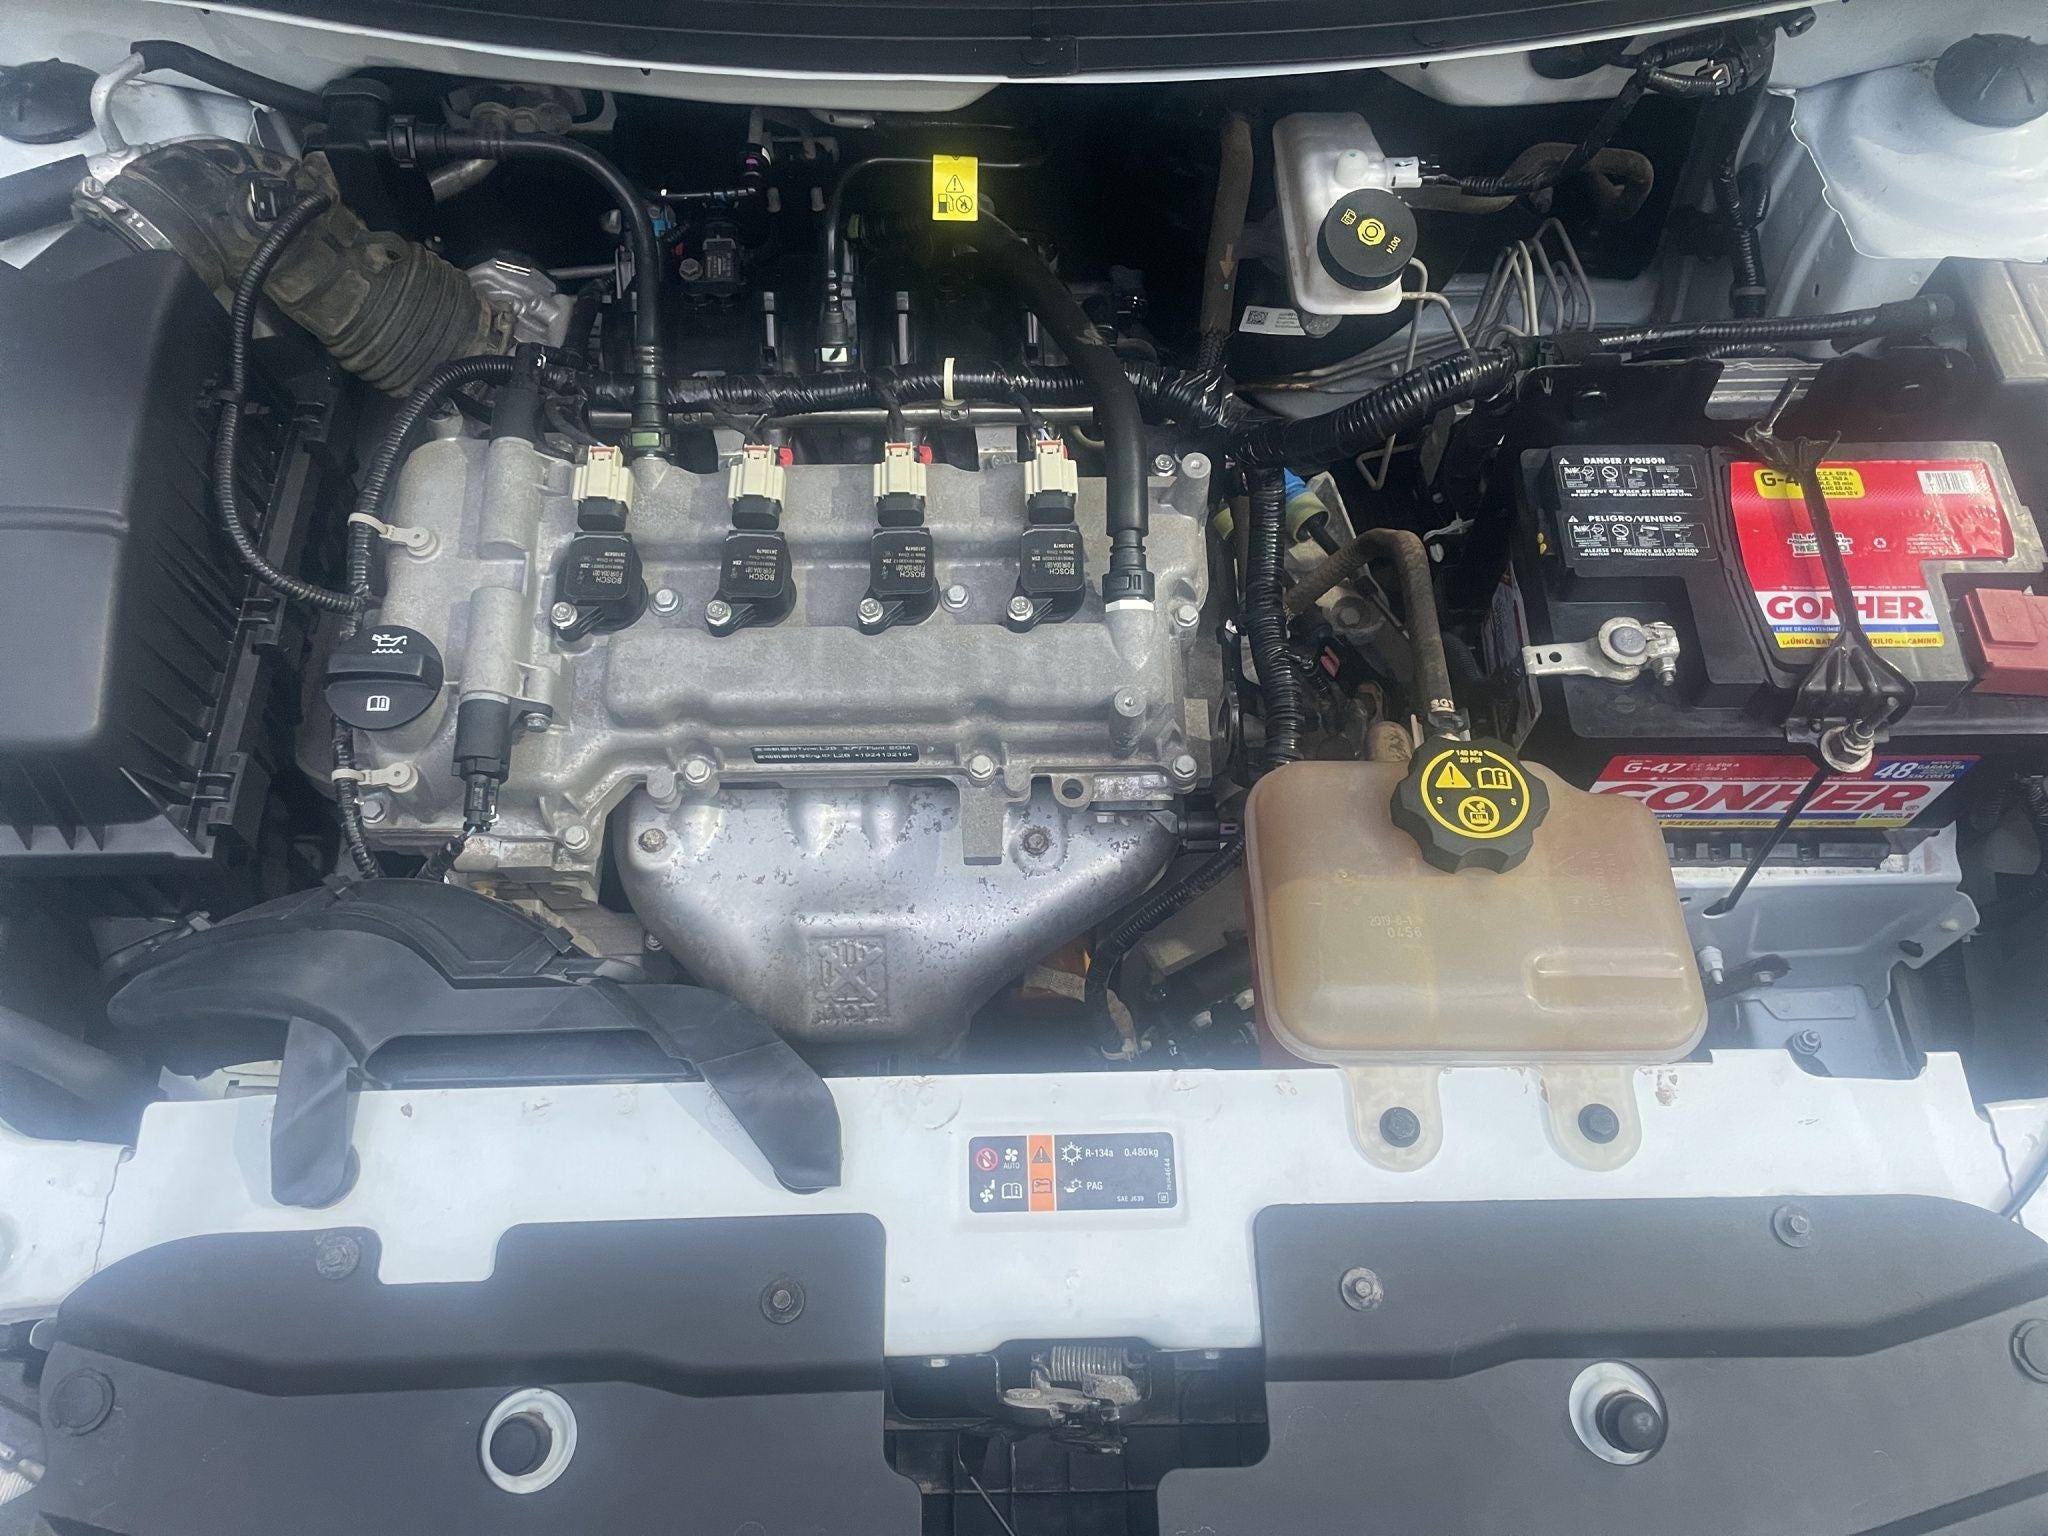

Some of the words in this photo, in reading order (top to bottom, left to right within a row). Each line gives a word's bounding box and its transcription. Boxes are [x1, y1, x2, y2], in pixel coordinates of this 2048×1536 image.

[1760, 472, 1800, 487] G-4
[1588, 515, 1682, 523] PELIGRO/VENENO
[1790, 636, 1814, 645] ÚNICA
[1624, 763, 1686, 773] G-47
[1874, 762, 1919, 778] 48
[1436, 796, 1444, 804] S
[1511, 798, 1517, 806] S
[1085, 1149, 1114, 1158] R-134a
[1086, 1182, 1103, 1191] PAG
